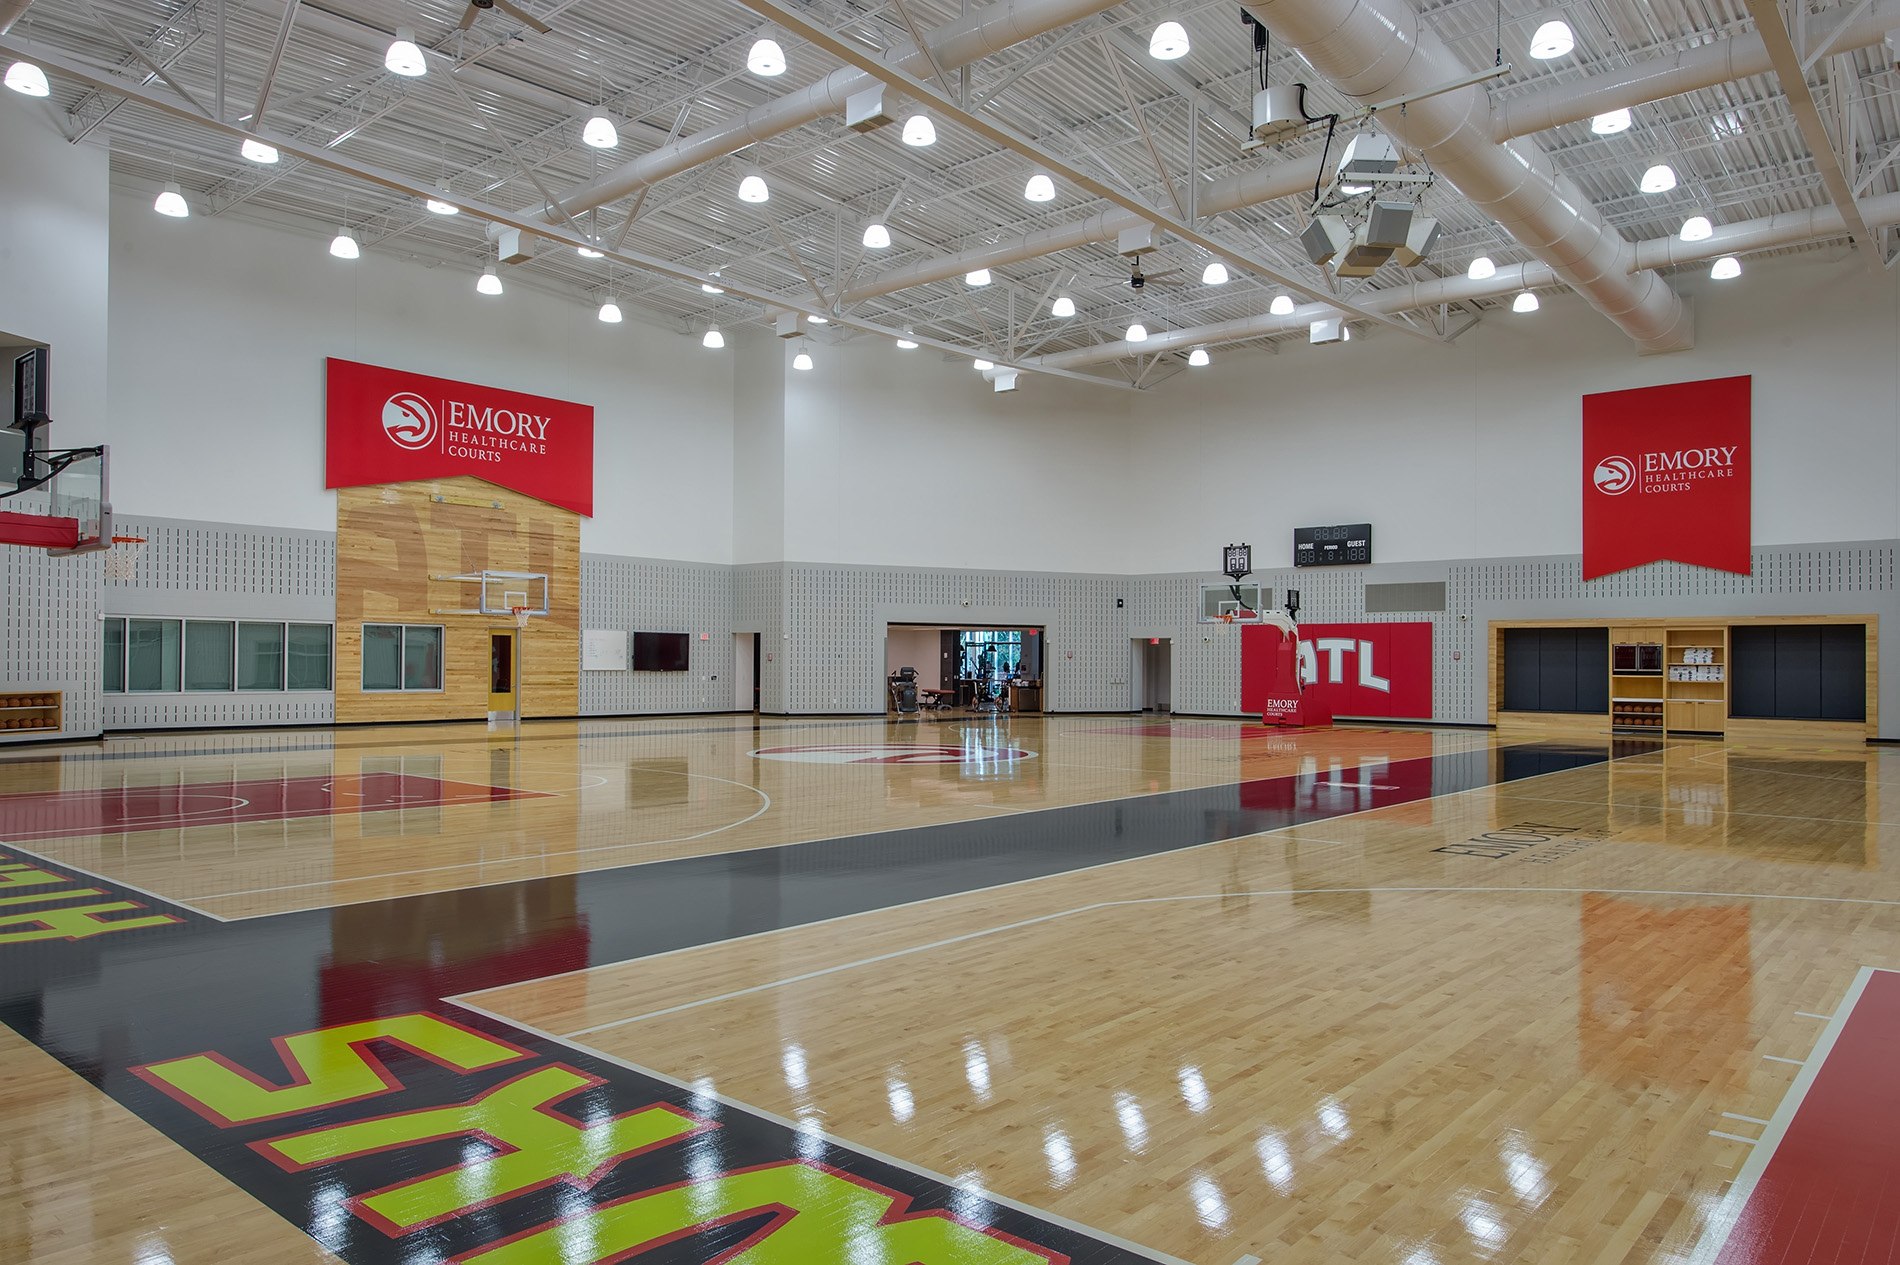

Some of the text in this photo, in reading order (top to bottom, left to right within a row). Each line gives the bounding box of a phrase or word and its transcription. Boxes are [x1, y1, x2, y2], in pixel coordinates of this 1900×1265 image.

[448, 401, 551, 441] EMORY
[449, 431, 546, 454] HEALTHCARE
[448, 446, 501, 462] COURTS
[1645, 445, 1737, 471] EMORY
[1646, 469, 1733, 483] HEALTHCARE
[1646, 483, 1692, 494] COURTS
[1267, 699, 1299, 708] EMORY
[1429, 821, 1582, 860] EMORY
